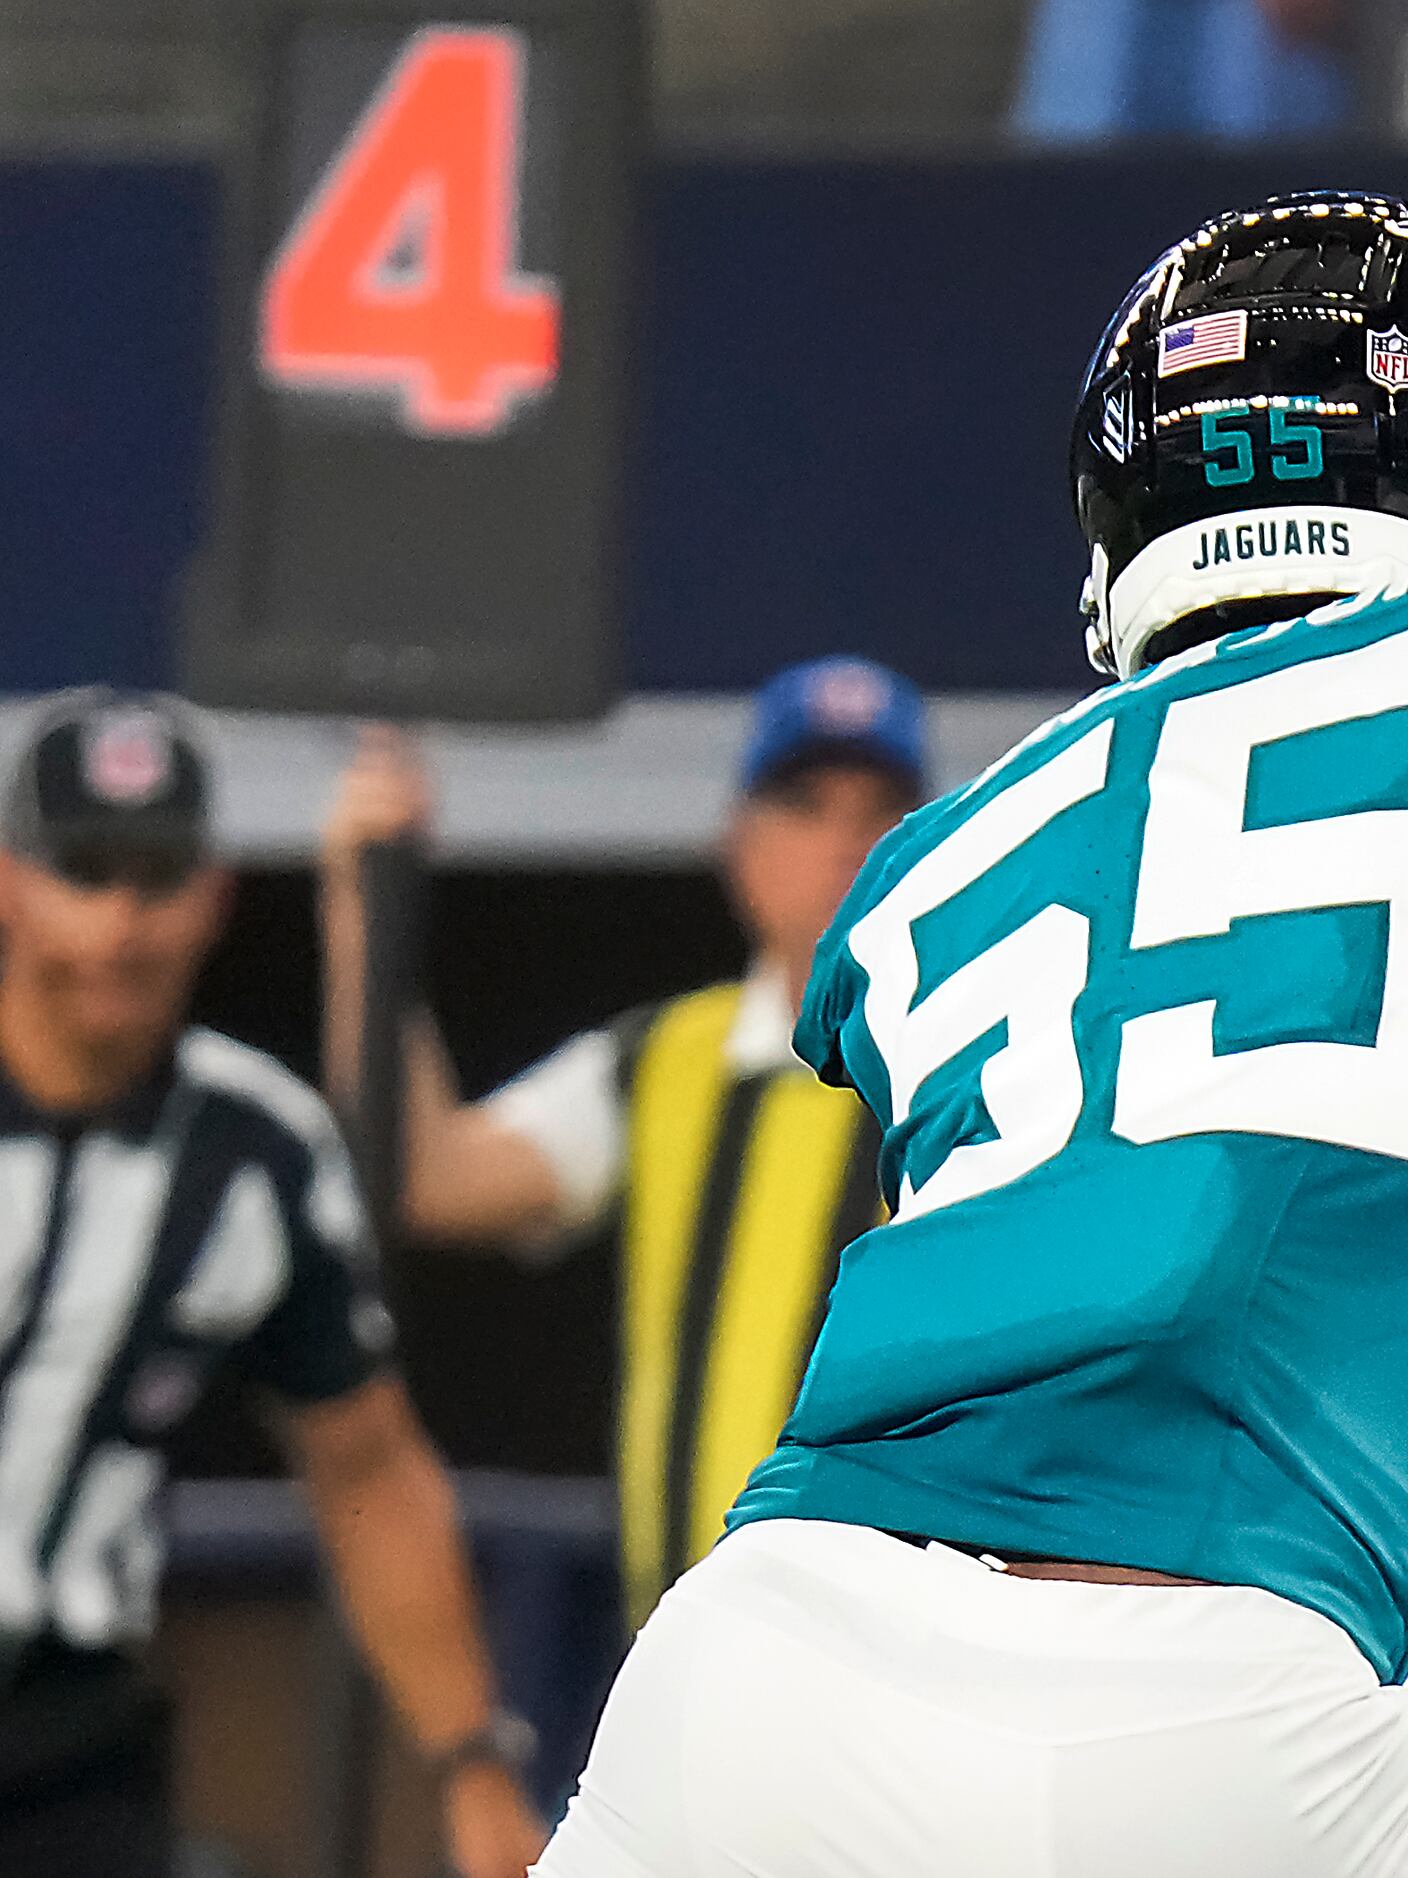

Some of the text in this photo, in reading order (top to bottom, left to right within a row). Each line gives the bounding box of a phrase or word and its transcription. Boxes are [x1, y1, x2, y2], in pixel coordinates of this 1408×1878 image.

[260, 28, 560, 434] 4
[1201, 395, 1323, 487] 55
[1192, 519, 1350, 570] JAGUARS
